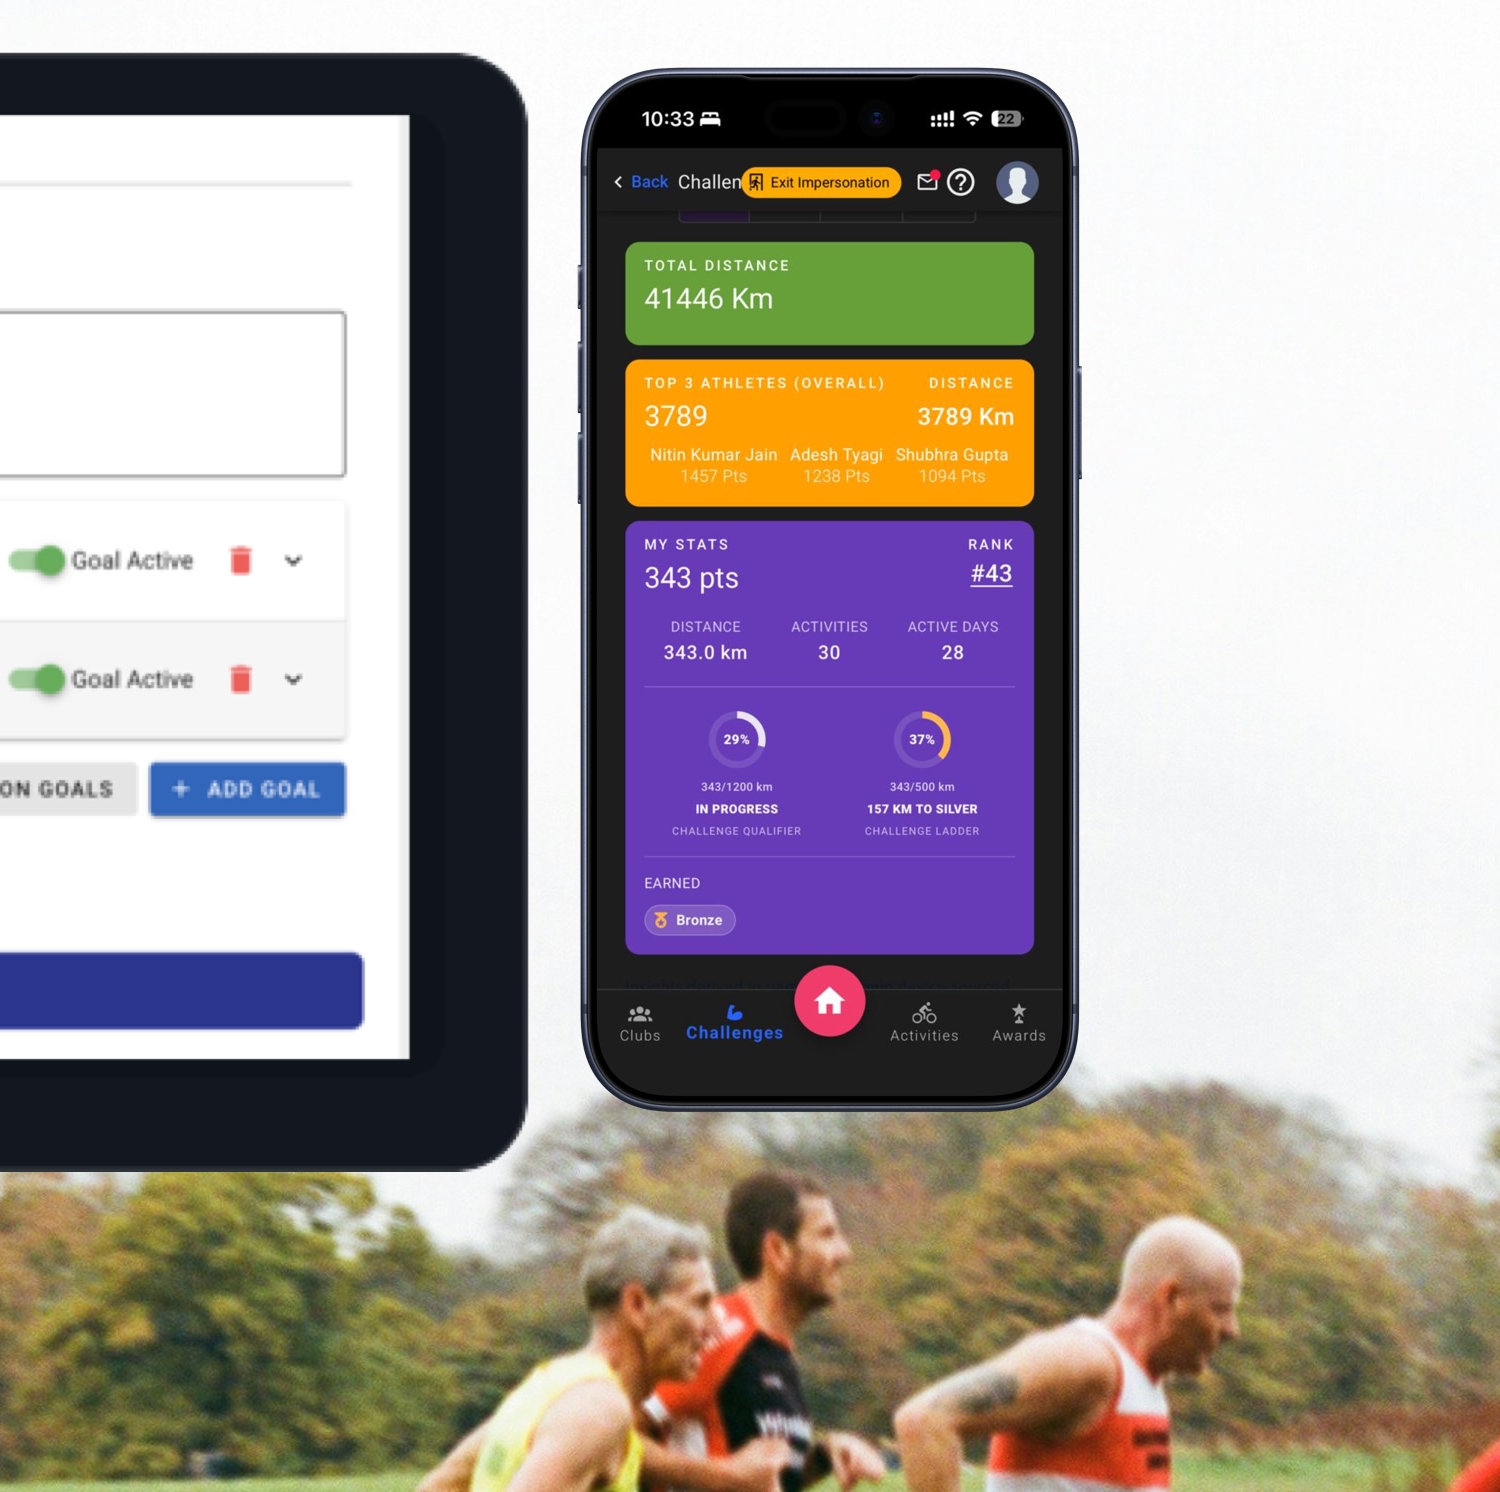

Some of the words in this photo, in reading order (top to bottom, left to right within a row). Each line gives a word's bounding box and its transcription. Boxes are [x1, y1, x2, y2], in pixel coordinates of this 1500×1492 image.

[641, 110, 695, 127] 10:33
[997, 113, 1015, 125] 22
[631, 174, 669, 189] Back
[771, 176, 794, 189] Exit
[797, 176, 890, 191] Impersonation
[644, 259, 697, 272] TOTAL
[705, 259, 789, 272] DISTANCE
[644, 287, 724, 310] 41446
[732, 287, 773, 310] Km
[644, 376, 677, 389] TOP
[684, 377, 693, 389] 3
[700, 376, 787, 389] ATHLETES
[794, 376, 884, 392] (OVERALL)
[929, 376, 1013, 389] DISTANCE
[645, 404, 708, 427] 3789
[918, 406, 973, 426] 3789
[979, 407, 1015, 426] Km
[650, 447, 686, 462] Nitin
[690, 447, 741, 462] Kumar
[745, 448, 778, 462] Jain
[789, 447, 838, 462] Adesh
[842, 447, 883, 465] Tyagi
[895, 447, 959, 462] Shubhra
[963, 447, 1009, 465] Gupta
[681, 468, 718, 483] 1457
[722, 469, 748, 483] Pts
[804, 468, 841, 483] 1238
[845, 469, 870, 483] Pts
[919, 468, 957, 483] 1094
[961, 468, 986, 483] Pts
[644, 538, 668, 551] MY
[675, 538, 728, 551] STATS
[968, 538, 1013, 551] RANK
[70, 550, 120, 571] Goal
[127, 550, 194, 571] Active
[645, 566, 691, 589] 343
[700, 567, 739, 595] pts
[971, 563, 1012, 583] #43
[671, 620, 741, 633] DISTANCE
[791, 620, 868, 633] ACTIVITIES
[907, 620, 958, 633] ACTIVE
[962, 620, 999, 633] DAYS
[663, 644, 715, 660] 343.0
[721, 644, 747, 660] km
[818, 644, 841, 660] 30
[941, 644, 964, 660] 28
[70, 669, 120, 689] Goal
[126, 669, 194, 689] Active
[723, 733, 750, 745] 29%
[909, 733, 936, 745] 37%
[37, 779, 113, 799] GOALS
[207, 779, 253, 799] ADD
[260, 779, 320, 799] GOAL
[701, 781, 754, 792] 343/1200
[756, 781, 773, 792] km
[889, 781, 936, 792] 343/500
[938, 781, 955, 792] km
[695, 803, 709, 814] IN
[712, 803, 779, 815] PROGRESS
[867, 803, 890, 815] 157
[892, 803, 912, 815] KM
[915, 803, 933, 815] TO
[935, 803, 978, 815] SILVER
[671, 826, 739, 836] CHALLENGE
[742, 826, 801, 837] QUALIFIER
[864, 826, 932, 836] CHALLENGE
[935, 826, 980, 836] LADDER
[644, 877, 701, 889] EARNED
[676, 914, 723, 926] Bronze
[619, 1029, 661, 1042] Clubs
[686, 1025, 783, 1043] Challenges
[890, 1029, 959, 1042] Activities
[992, 1029, 1046, 1042] Awards
